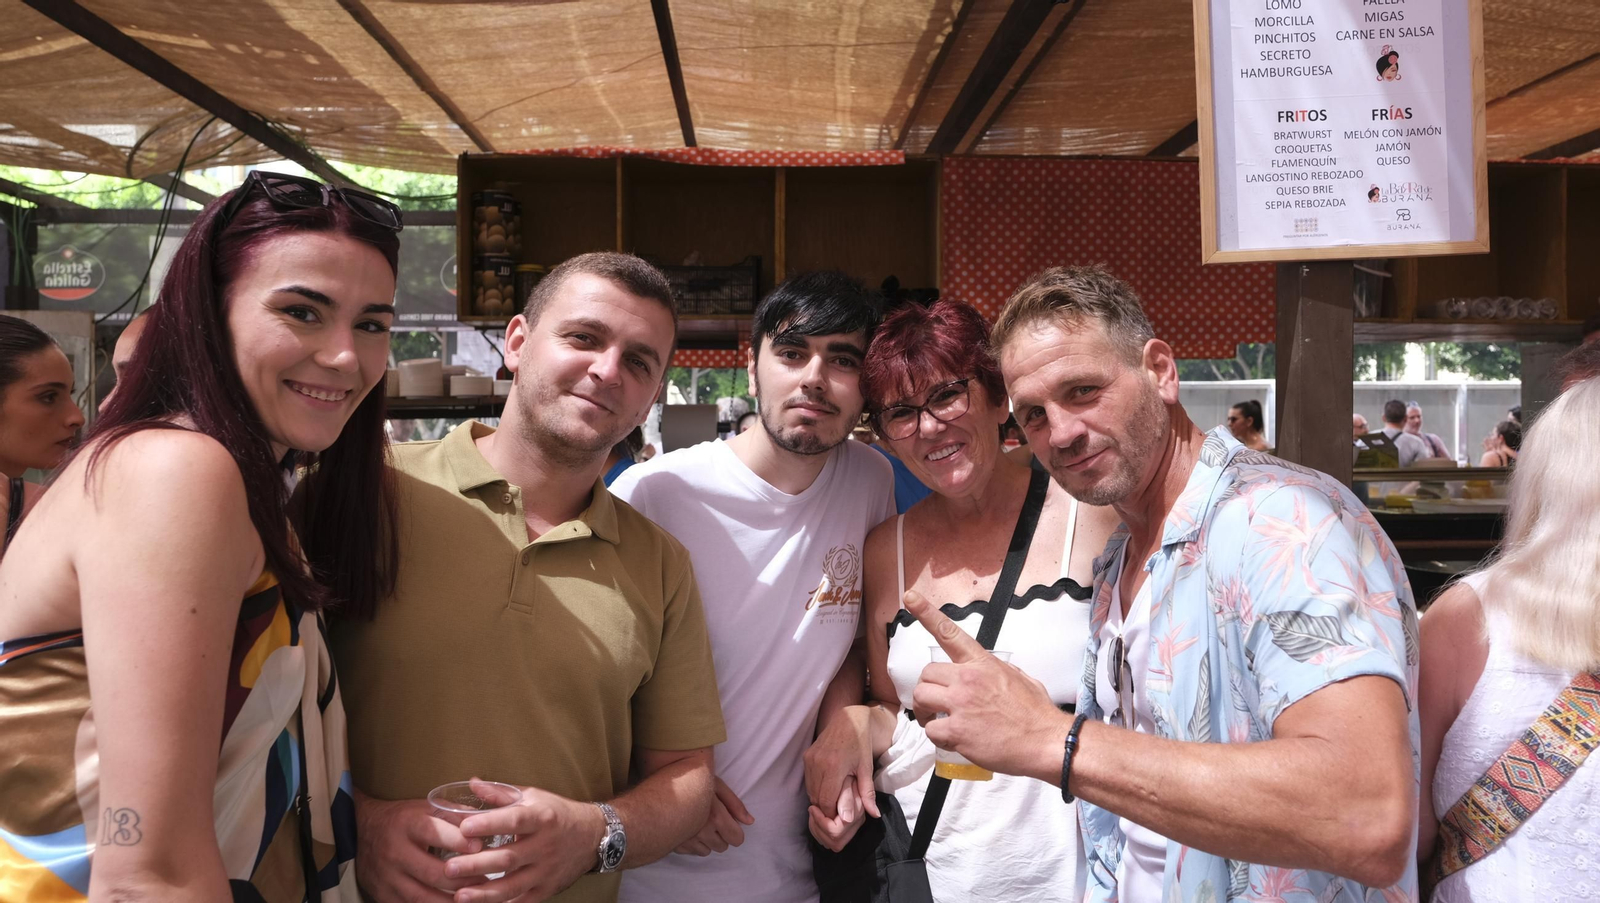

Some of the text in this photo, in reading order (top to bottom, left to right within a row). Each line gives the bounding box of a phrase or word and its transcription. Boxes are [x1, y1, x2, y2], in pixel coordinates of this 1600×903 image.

[1266, 0, 1301, 10] LOMO
[1255, 15, 1314, 27] MORCILLA
[1365, 11, 1404, 23] MIGAS
[1255, 32, 1316, 44] PINCHITOS
[1336, 26, 1434, 41] CARNE EN SALSA
[1260, 49, 1311, 61] SECRETO
[1241, 65, 1333, 78] HAMBURGUESA
[1278, 109, 1327, 123] FRITOS
[1372, 105, 1413, 121] FRÍAS
[1274, 130, 1332, 140] BRATWURST
[1344, 125, 1441, 139] MELÓN CON JAMÓN
[1275, 144, 1332, 154] CROQUETAS
[1375, 141, 1410, 152] JAMÓN
[1272, 155, 1336, 168] FLAMENQUÍN
[1377, 156, 1410, 166] QUESO
[1246, 170, 1363, 183] LANGOSTINO REBOZADO
[1276, 185, 1333, 197] QUESO BRIE
[1265, 198, 1346, 210] SEPIA REBOZADA
[1381, 194, 1433, 203] BURANA
[101, 807, 142, 846] 13
